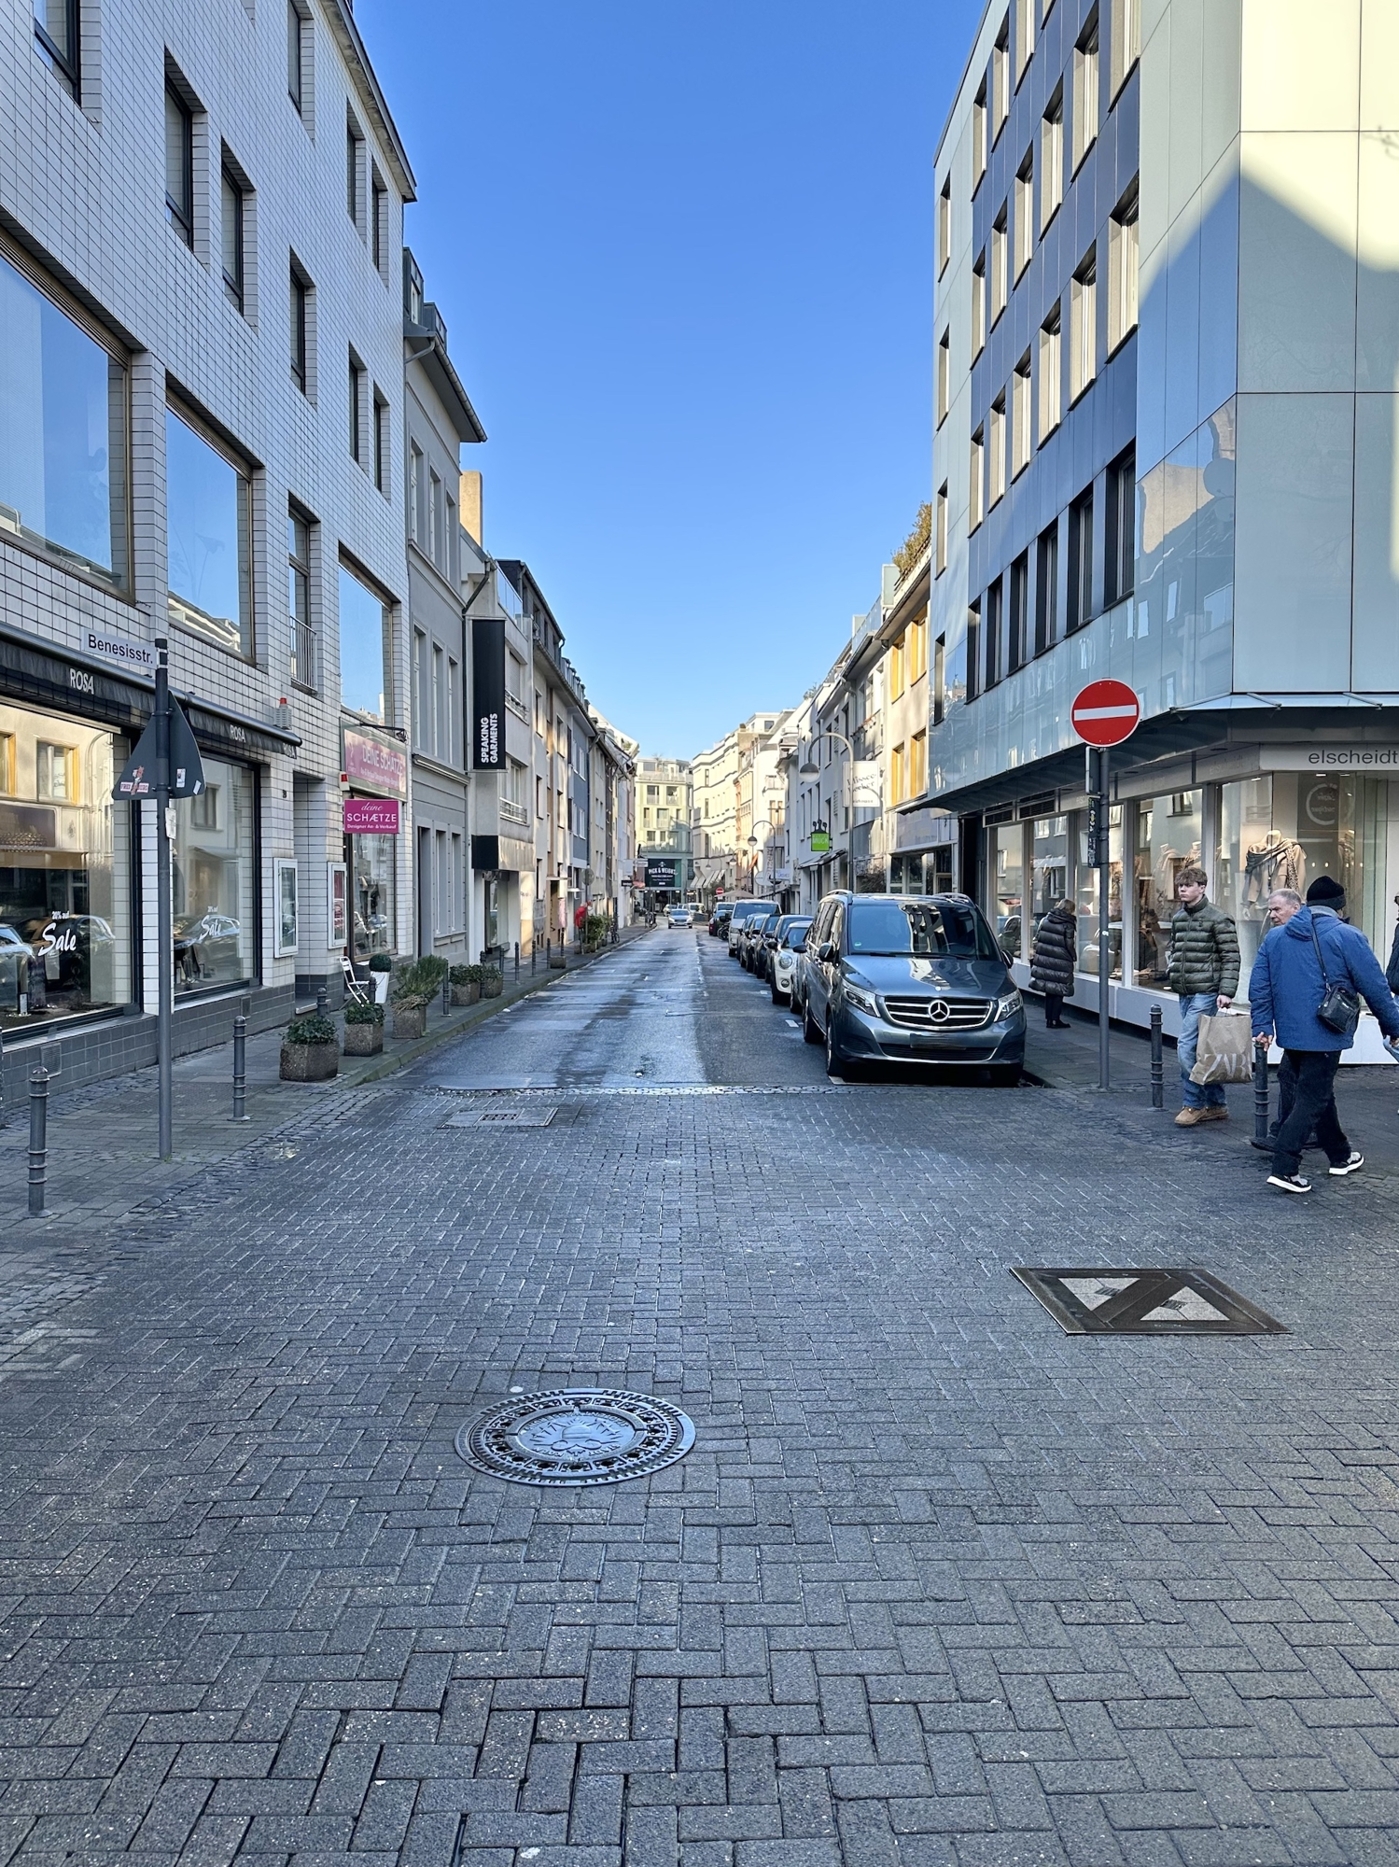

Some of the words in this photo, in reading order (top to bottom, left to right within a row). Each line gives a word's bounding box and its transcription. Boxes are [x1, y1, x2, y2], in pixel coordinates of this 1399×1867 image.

[88, 633, 153, 664] Benesisstr.
[69, 667, 95, 694] ROSA
[229, 724, 246, 743] ROSA
[481, 717, 489, 763] SPEAKING
[490, 713, 498, 763] GARMENTS
[362, 744, 380, 767] DEINE
[1308, 749, 1398, 764] elscheidt
[361, 802, 383, 811] deine
[37, 922, 77, 957] Sale
